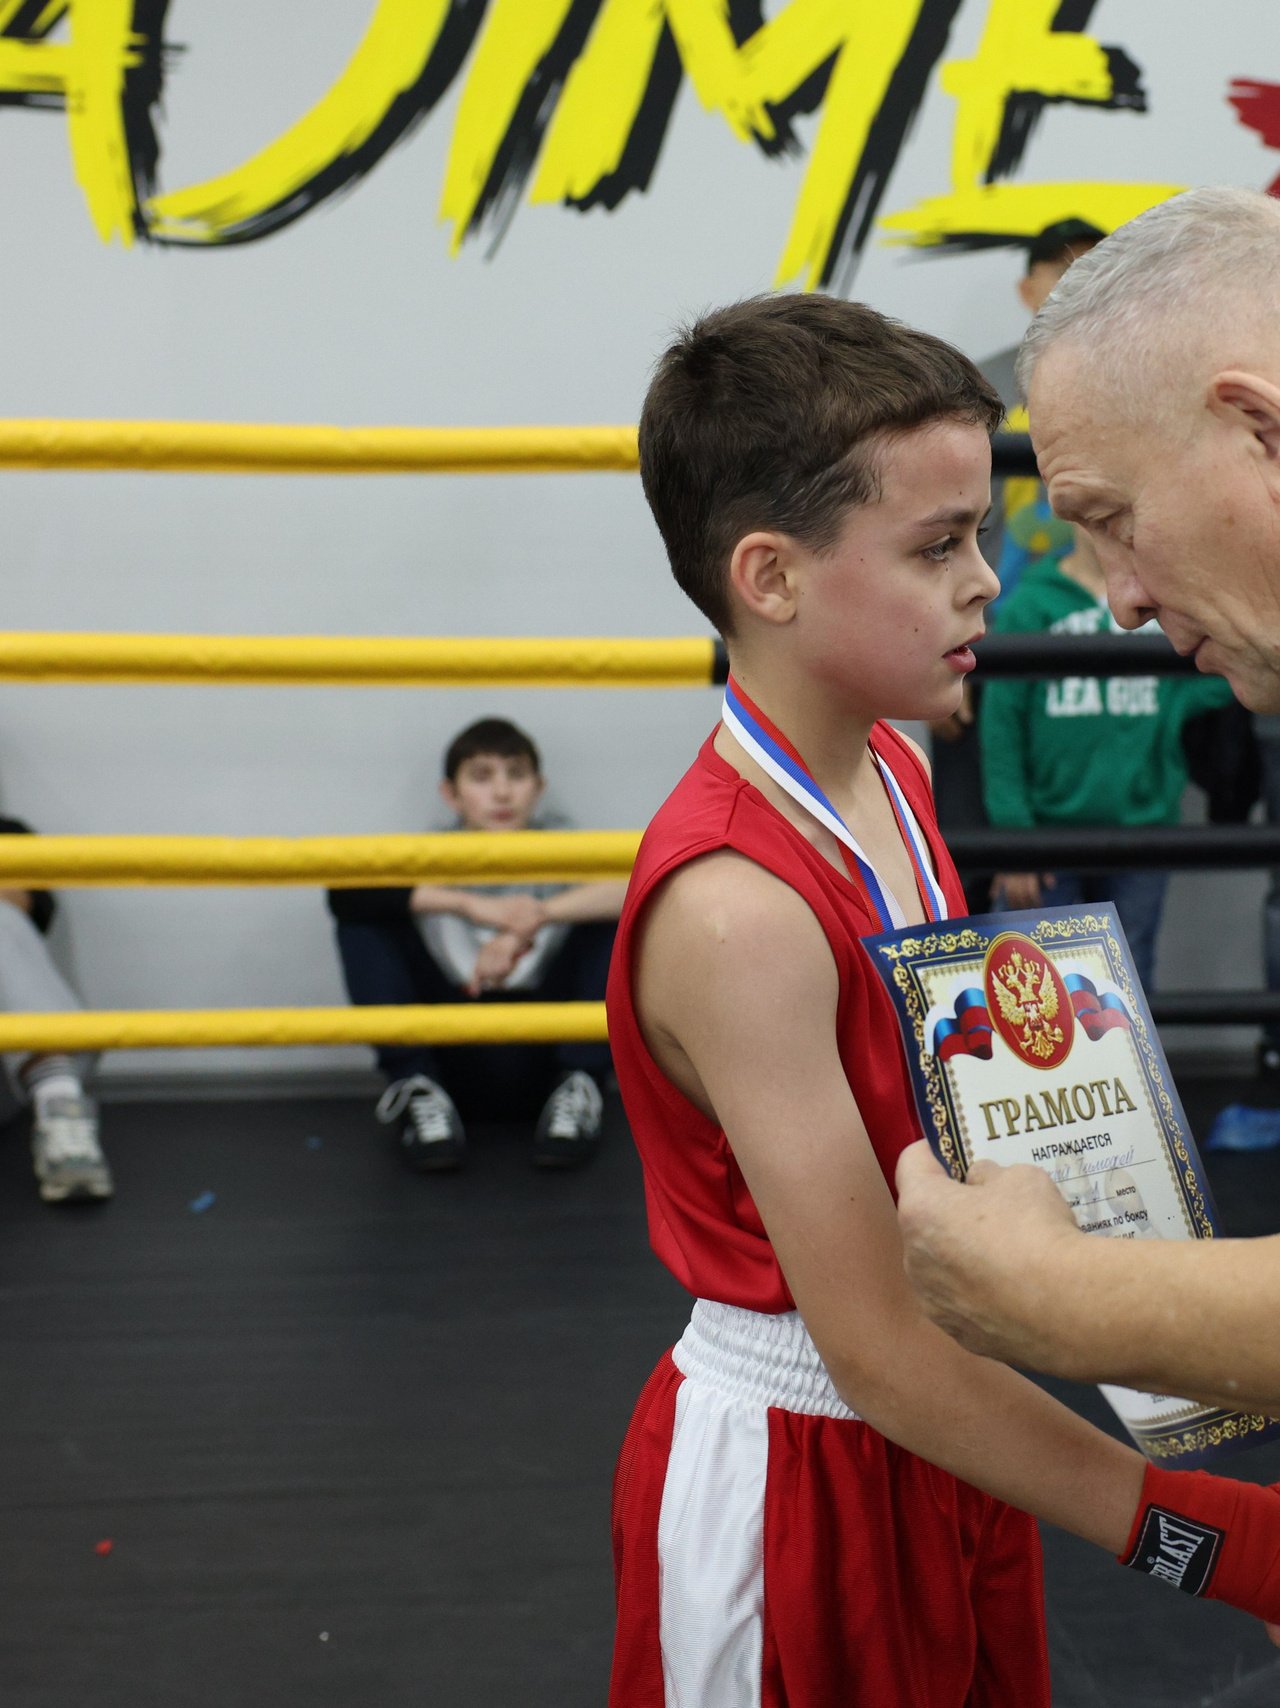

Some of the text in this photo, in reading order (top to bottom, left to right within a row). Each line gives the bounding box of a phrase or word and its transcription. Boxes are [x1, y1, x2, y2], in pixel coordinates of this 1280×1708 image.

[979, 1077, 1137, 1140] ГРАМОТА
[1031, 1133, 1113, 1162] НАГРАЖДАЕТСЯ
[1115, 1185, 1137, 1197] место
[1113, 1214, 1124, 1226] по
[1124, 1208, 1149, 1222] боксу
